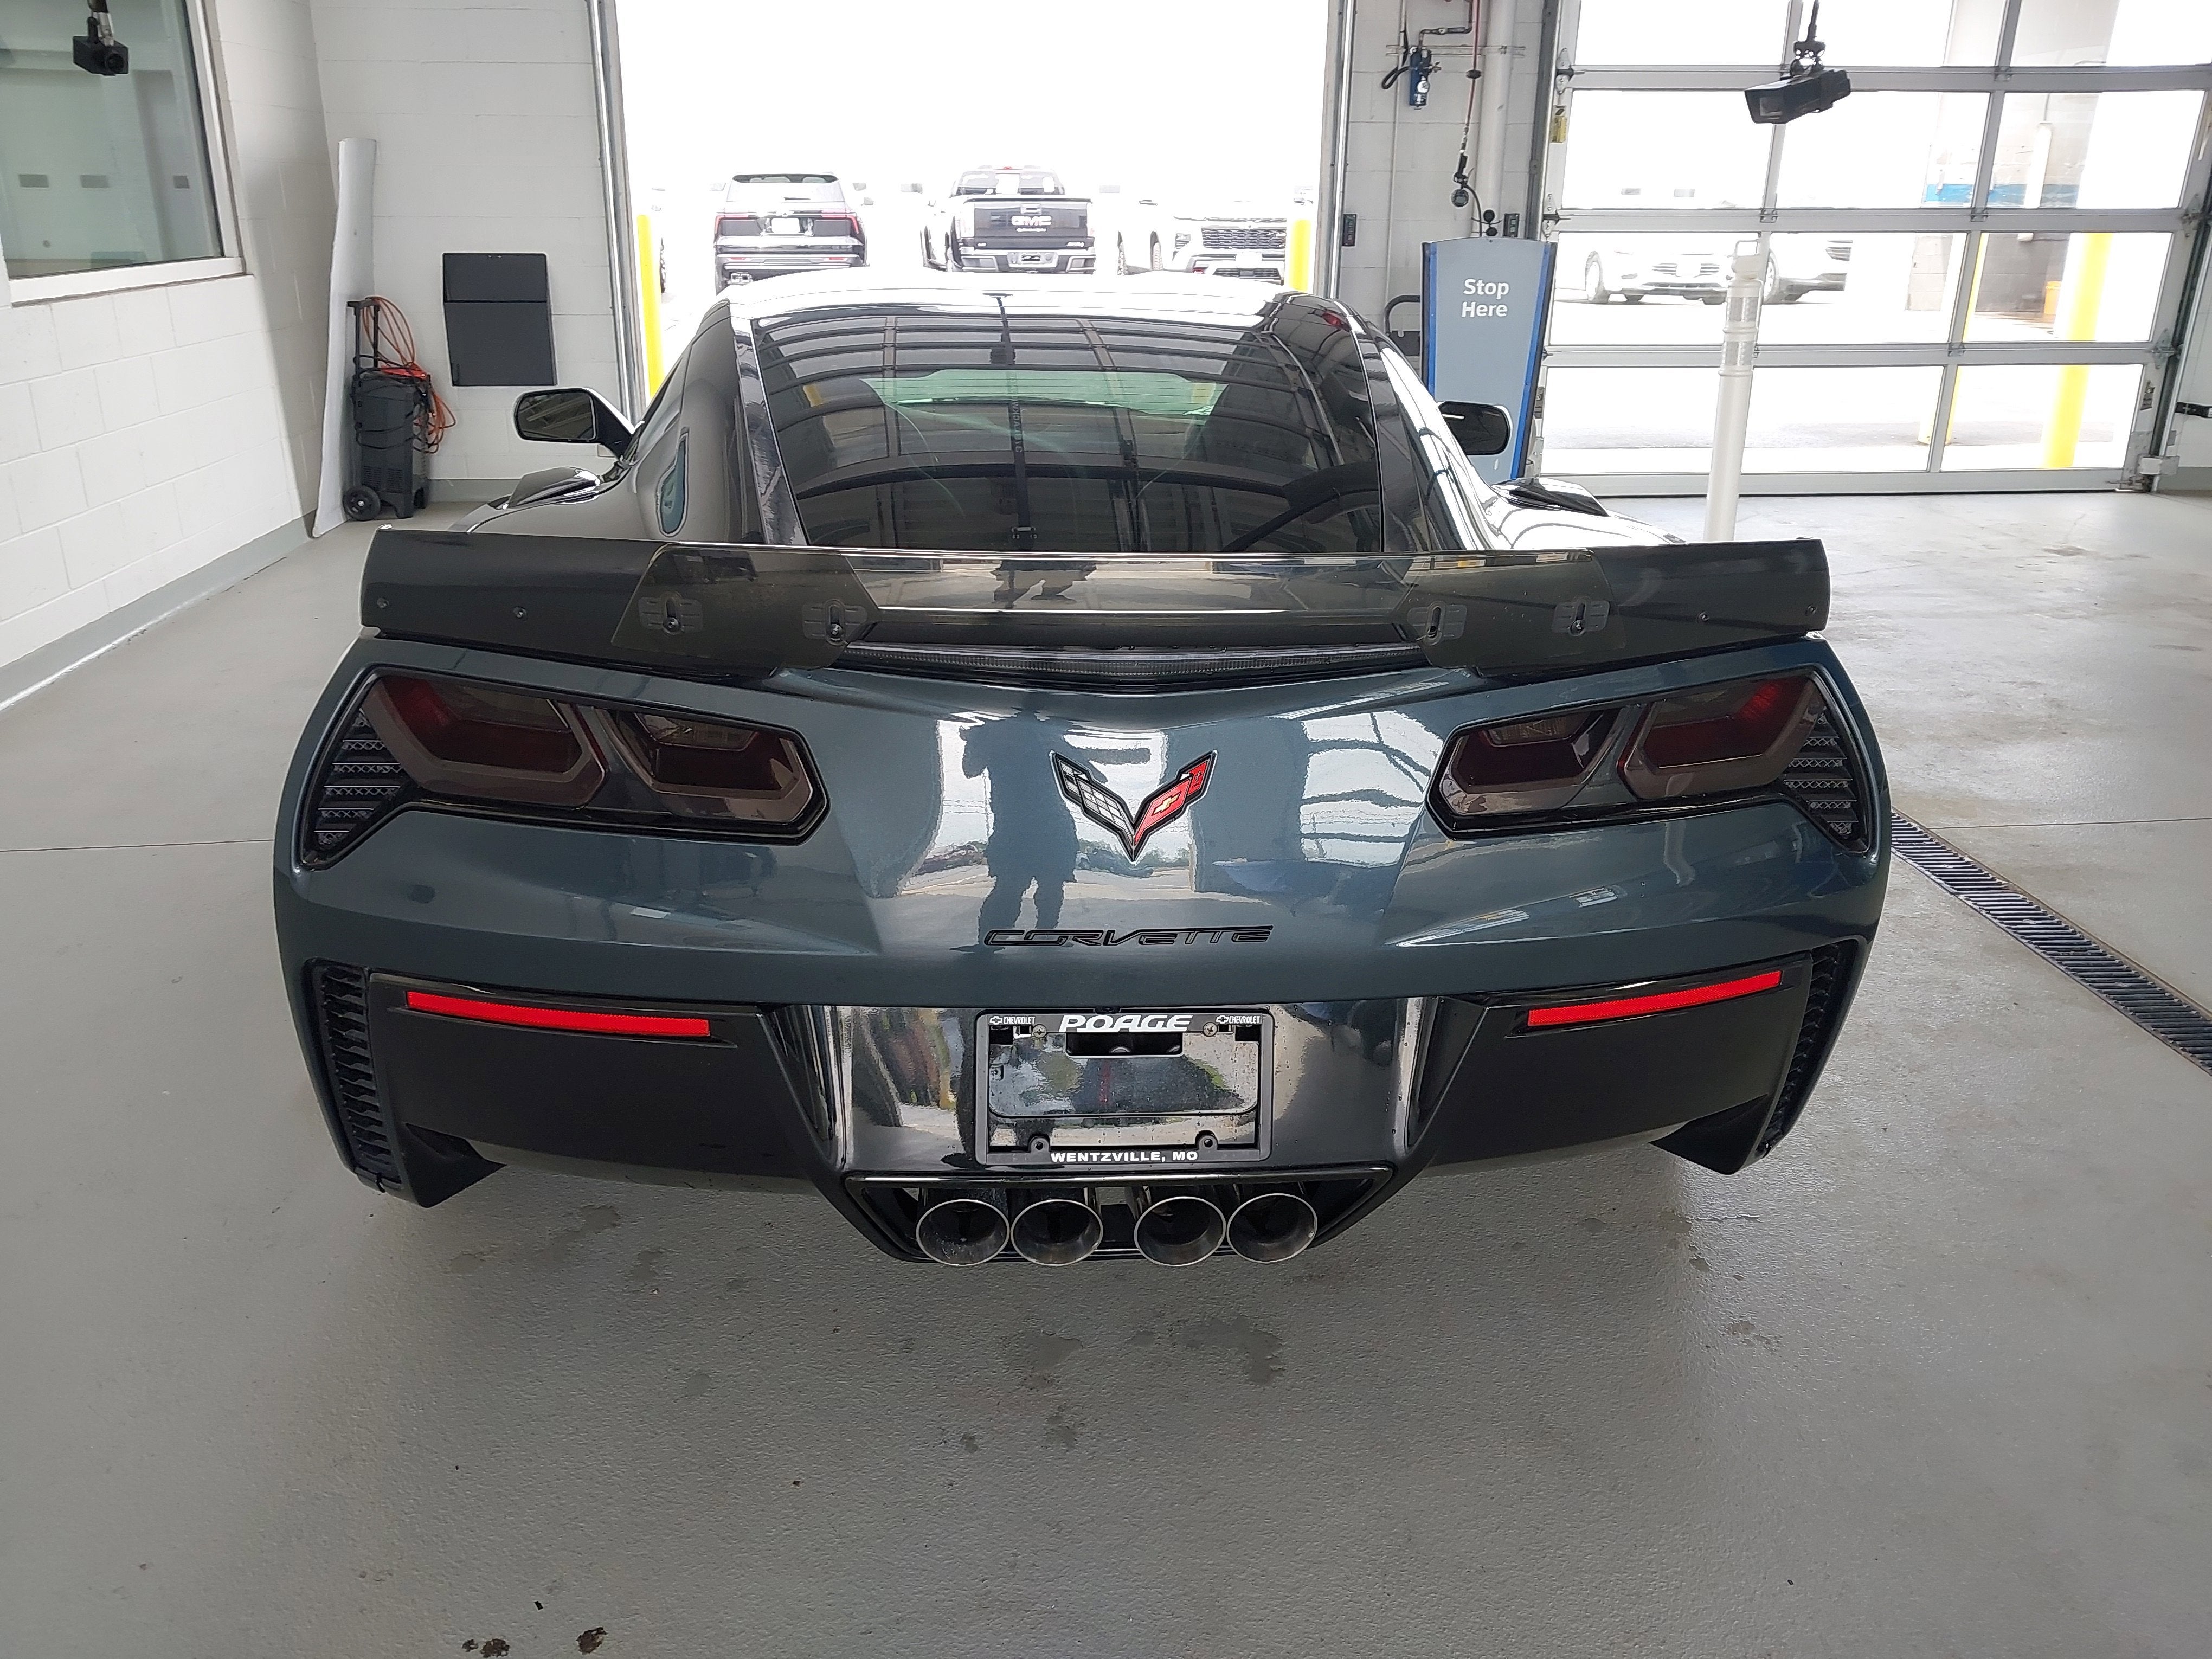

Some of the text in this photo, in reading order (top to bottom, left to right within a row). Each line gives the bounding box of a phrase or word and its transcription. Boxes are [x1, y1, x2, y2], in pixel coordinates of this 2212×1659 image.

[1463, 278, 1509, 300] Stop
[1461, 301, 1508, 317] Here
[983, 925, 1274, 946] CORVETTE
[1004, 1016, 1036, 1025] CHEVROLET
[1058, 1014, 1193, 1033] POAGE
[1229, 1015, 1261, 1024] CHEVROLET
[1050, 1151, 1198, 1162] WENTZVILLE, MO
